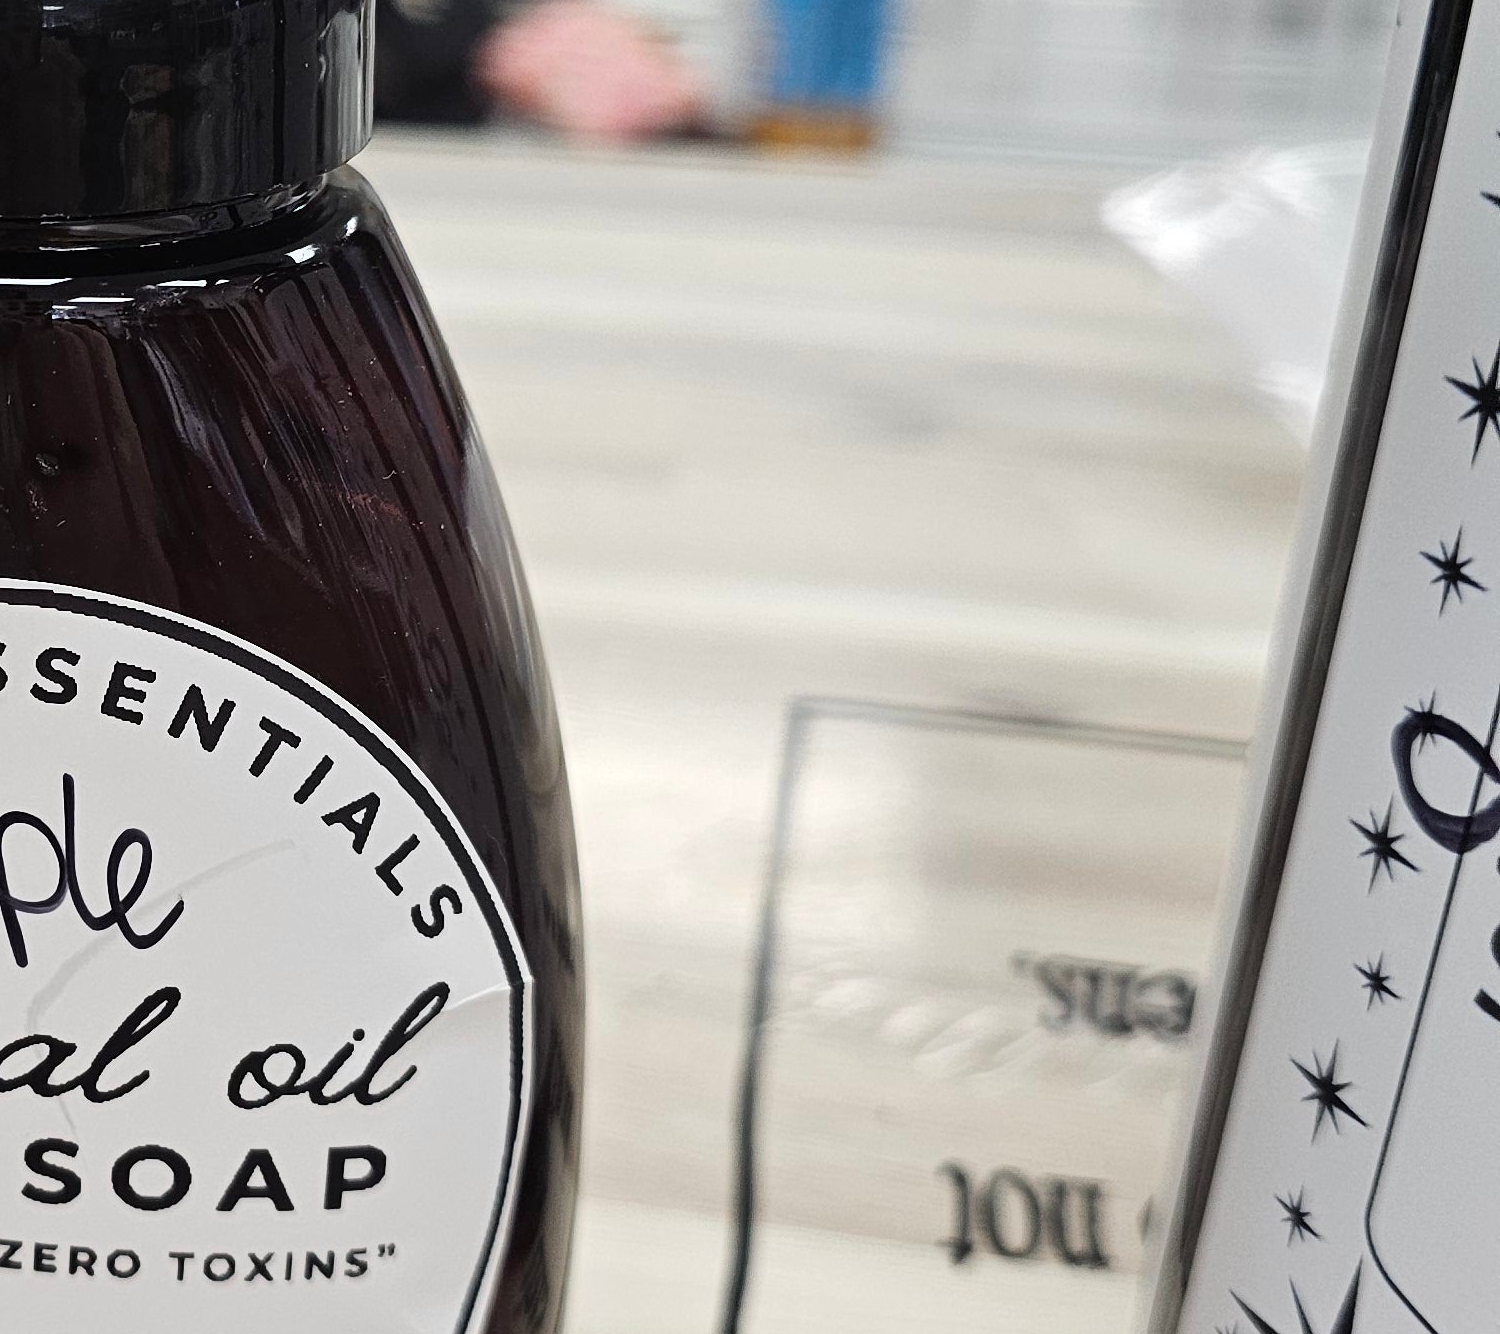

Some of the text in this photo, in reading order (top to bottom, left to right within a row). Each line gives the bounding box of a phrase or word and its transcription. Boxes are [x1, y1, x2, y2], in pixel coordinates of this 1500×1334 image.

[227, 981, 450, 1110] oil
[21, 1137, 387, 1212] SOAP
[936, 1157, 1109, 1270] not
[168, 1243, 396, 1282] TOXINS”
